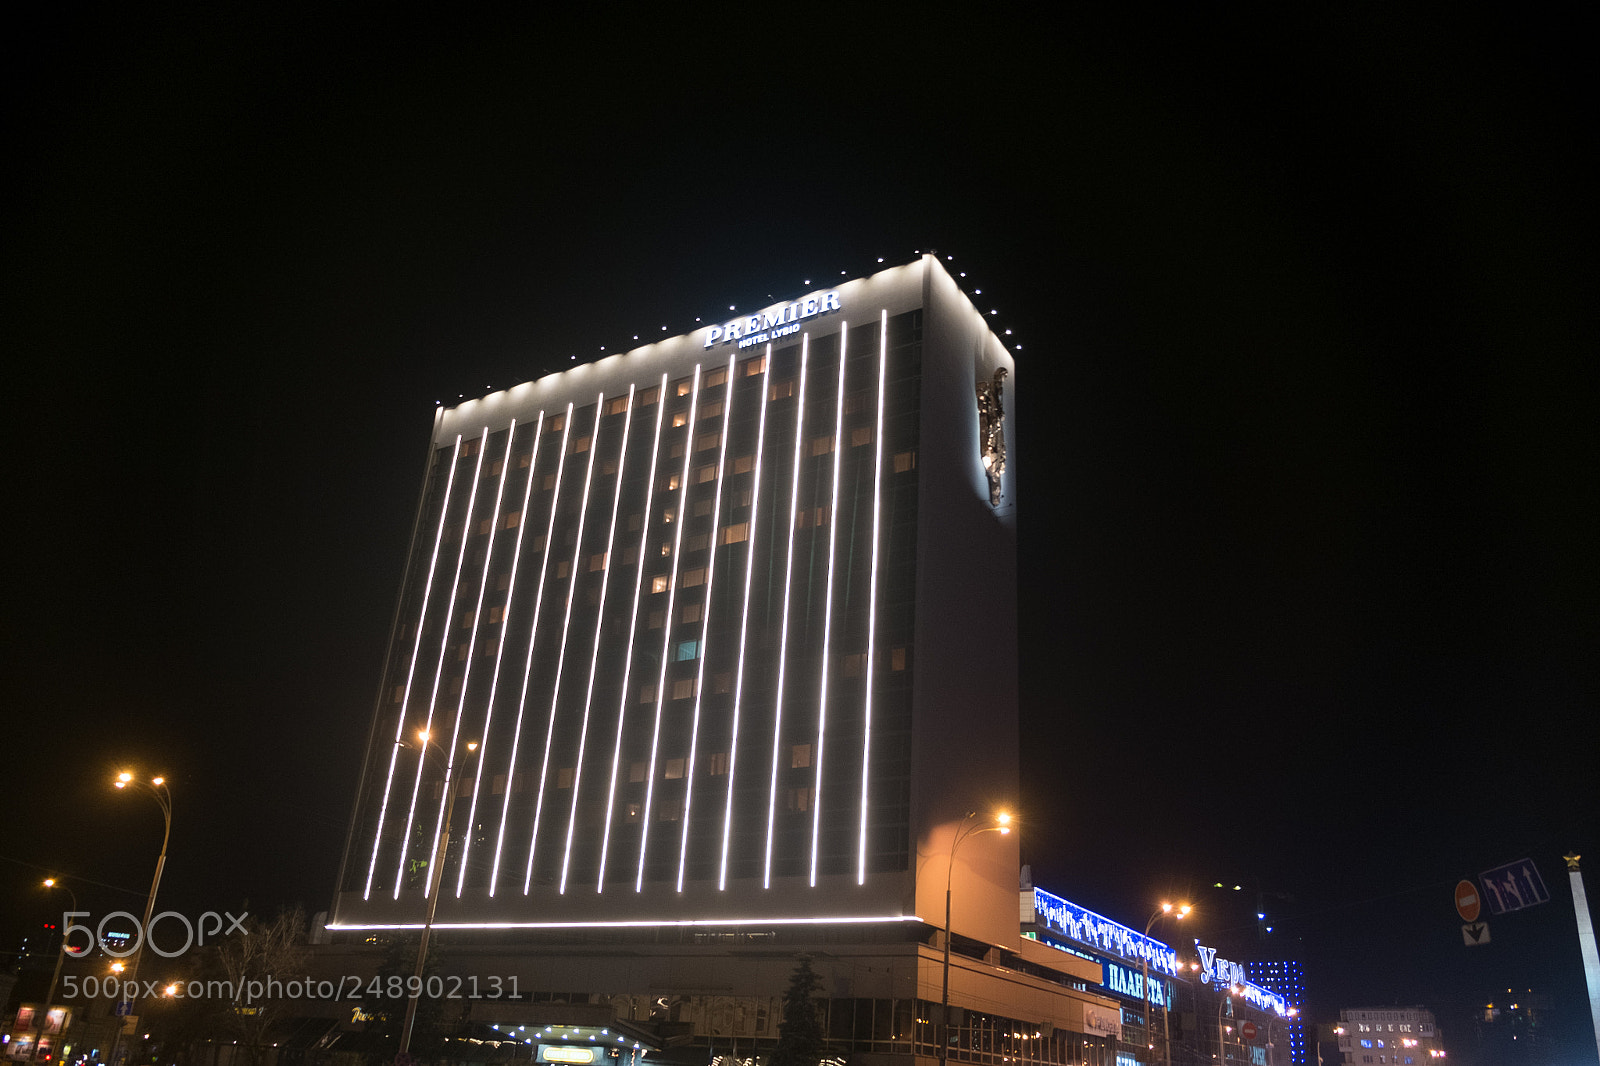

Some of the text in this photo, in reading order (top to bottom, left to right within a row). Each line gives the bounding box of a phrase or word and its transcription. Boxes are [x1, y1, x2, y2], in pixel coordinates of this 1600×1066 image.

[704, 290, 841, 348] PREMIER
[739, 324, 800, 348] HOTEL LYBID
